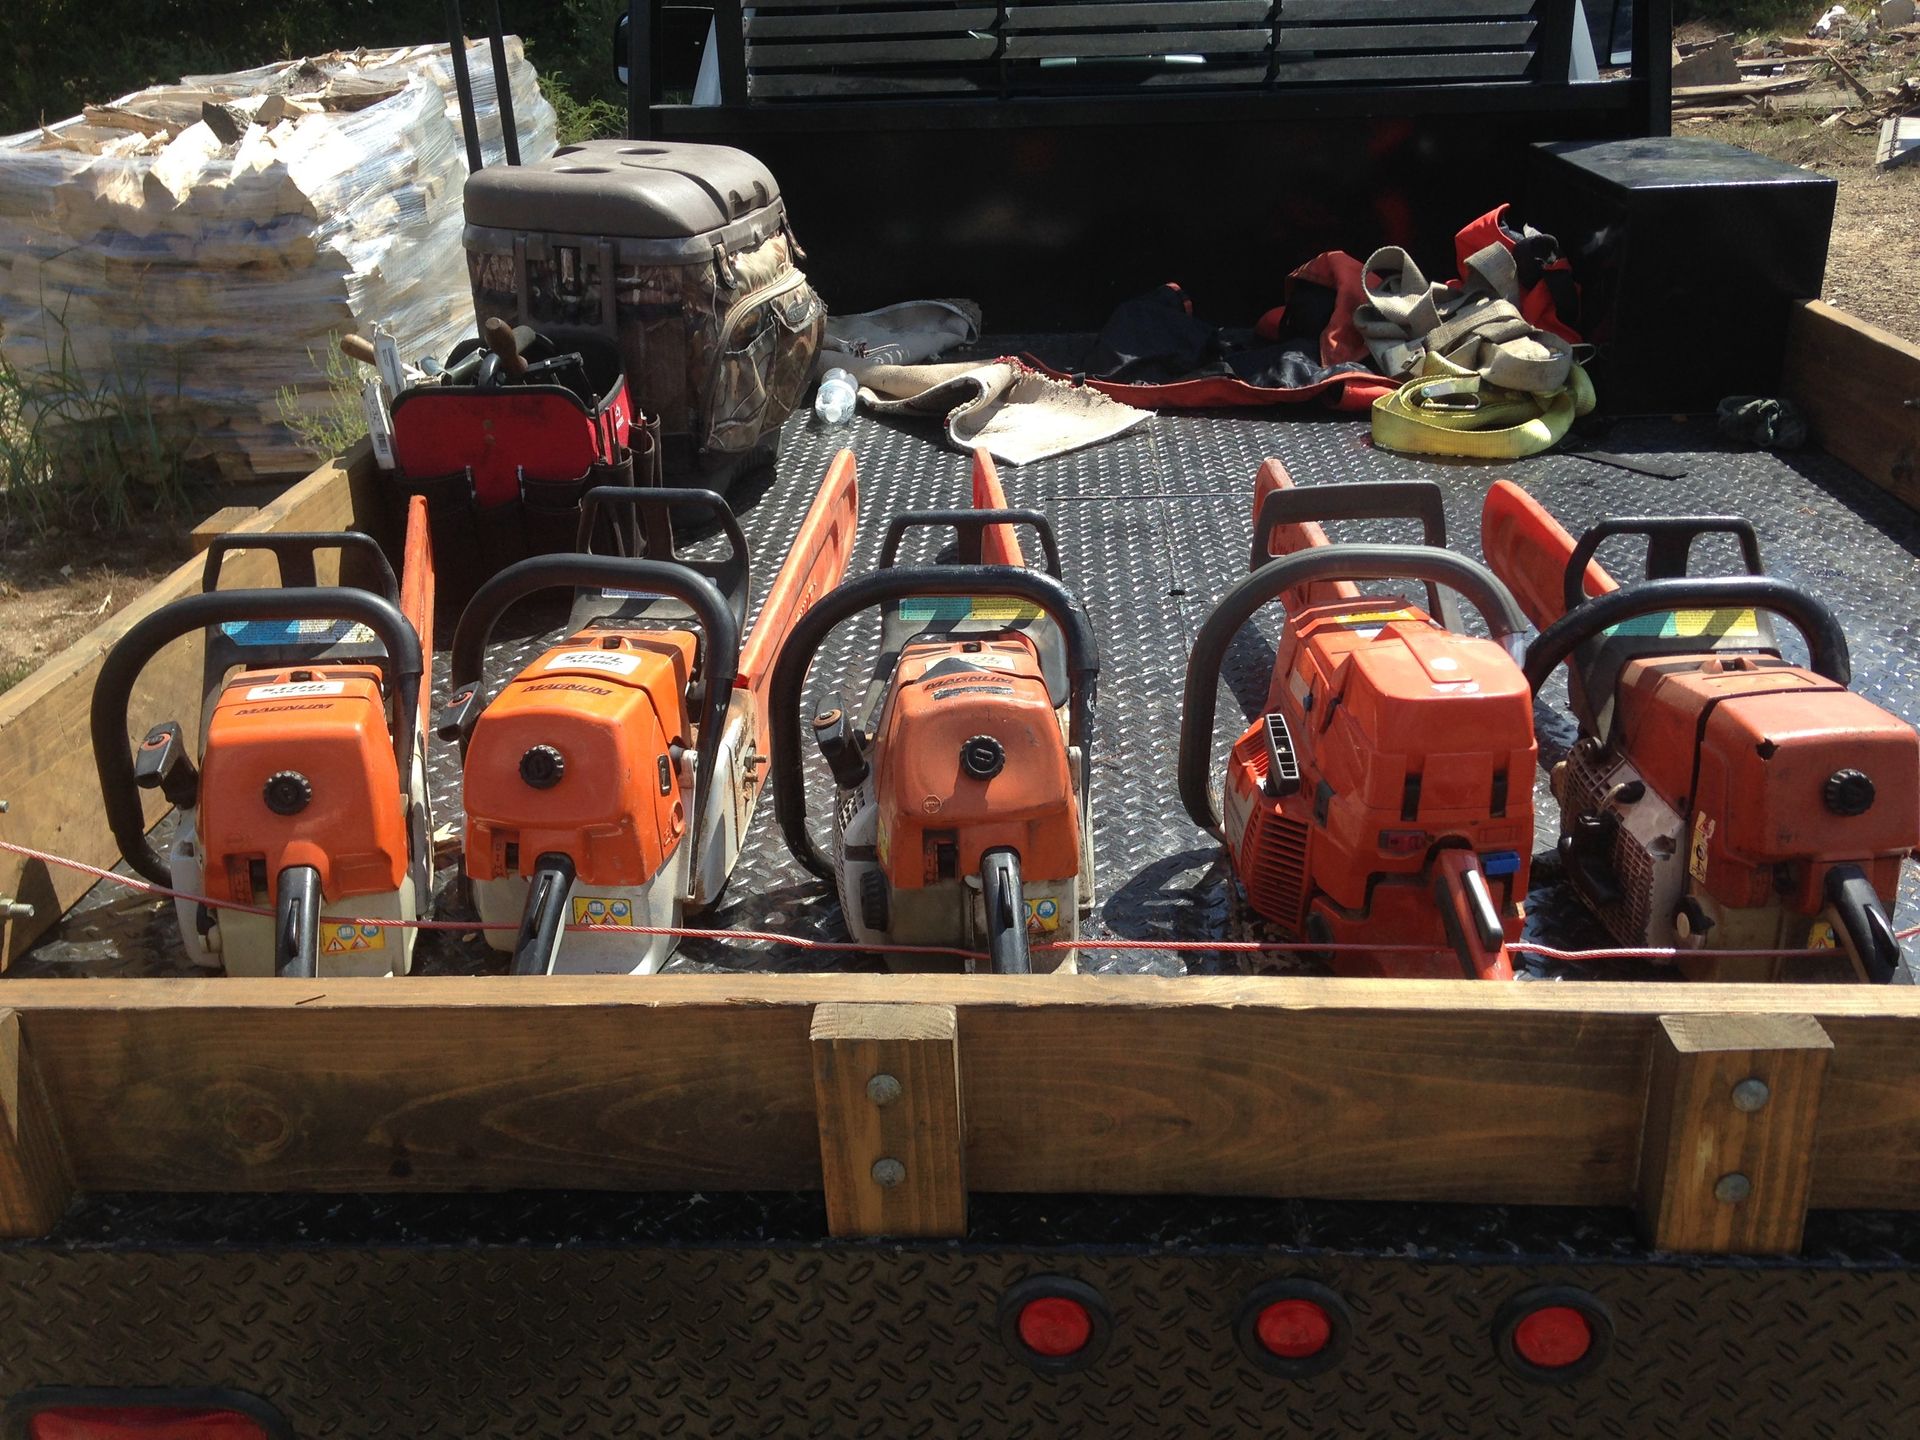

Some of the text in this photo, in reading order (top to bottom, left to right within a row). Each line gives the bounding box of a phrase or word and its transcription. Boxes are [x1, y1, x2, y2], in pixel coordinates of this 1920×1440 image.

[521, 682, 614, 696] MAGNUM
[923, 676, 1014, 691] MAGNUM
[235, 703, 334, 716] MAGNUM
